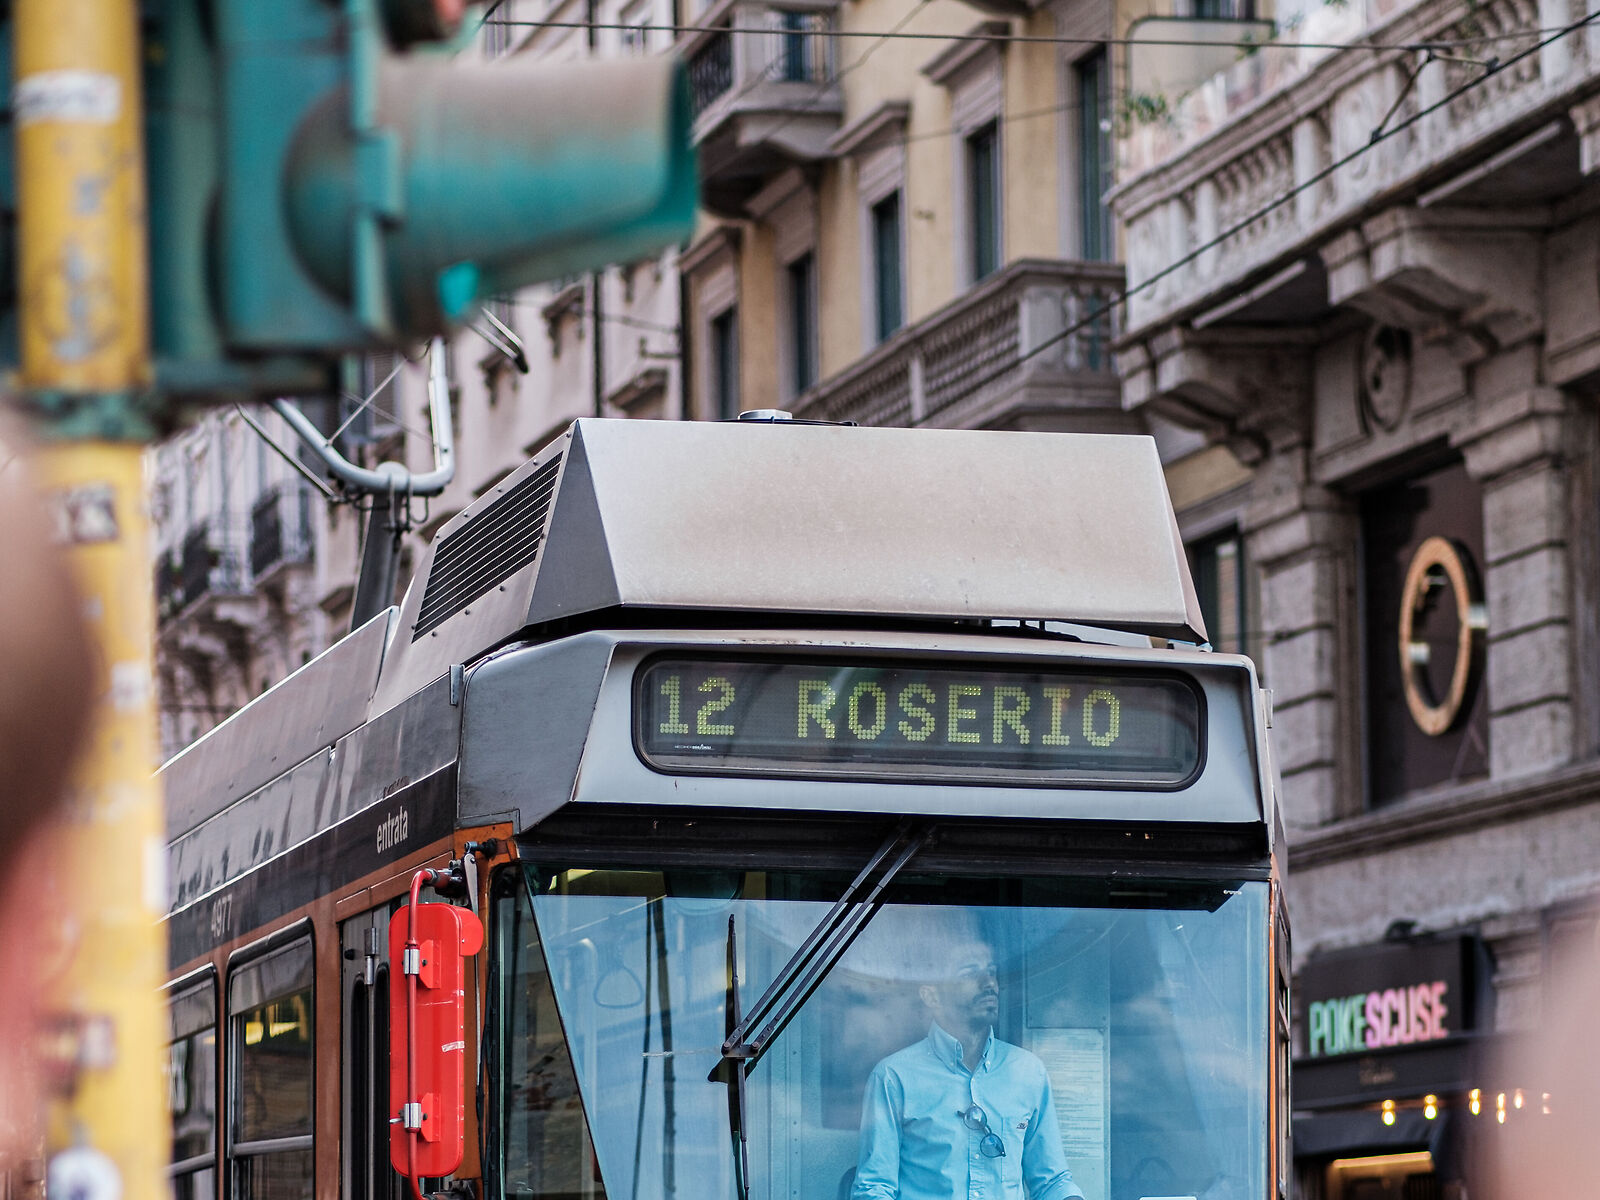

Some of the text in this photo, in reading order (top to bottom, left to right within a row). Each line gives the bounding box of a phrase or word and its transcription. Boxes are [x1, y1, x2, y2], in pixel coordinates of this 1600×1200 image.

[660, 676, 1121, 747] 12 ROSERIO
[376, 806, 408, 854] entrata
[211, 894, 233, 937] 4977
[1309, 982, 1448, 1058] POKESCUSE
